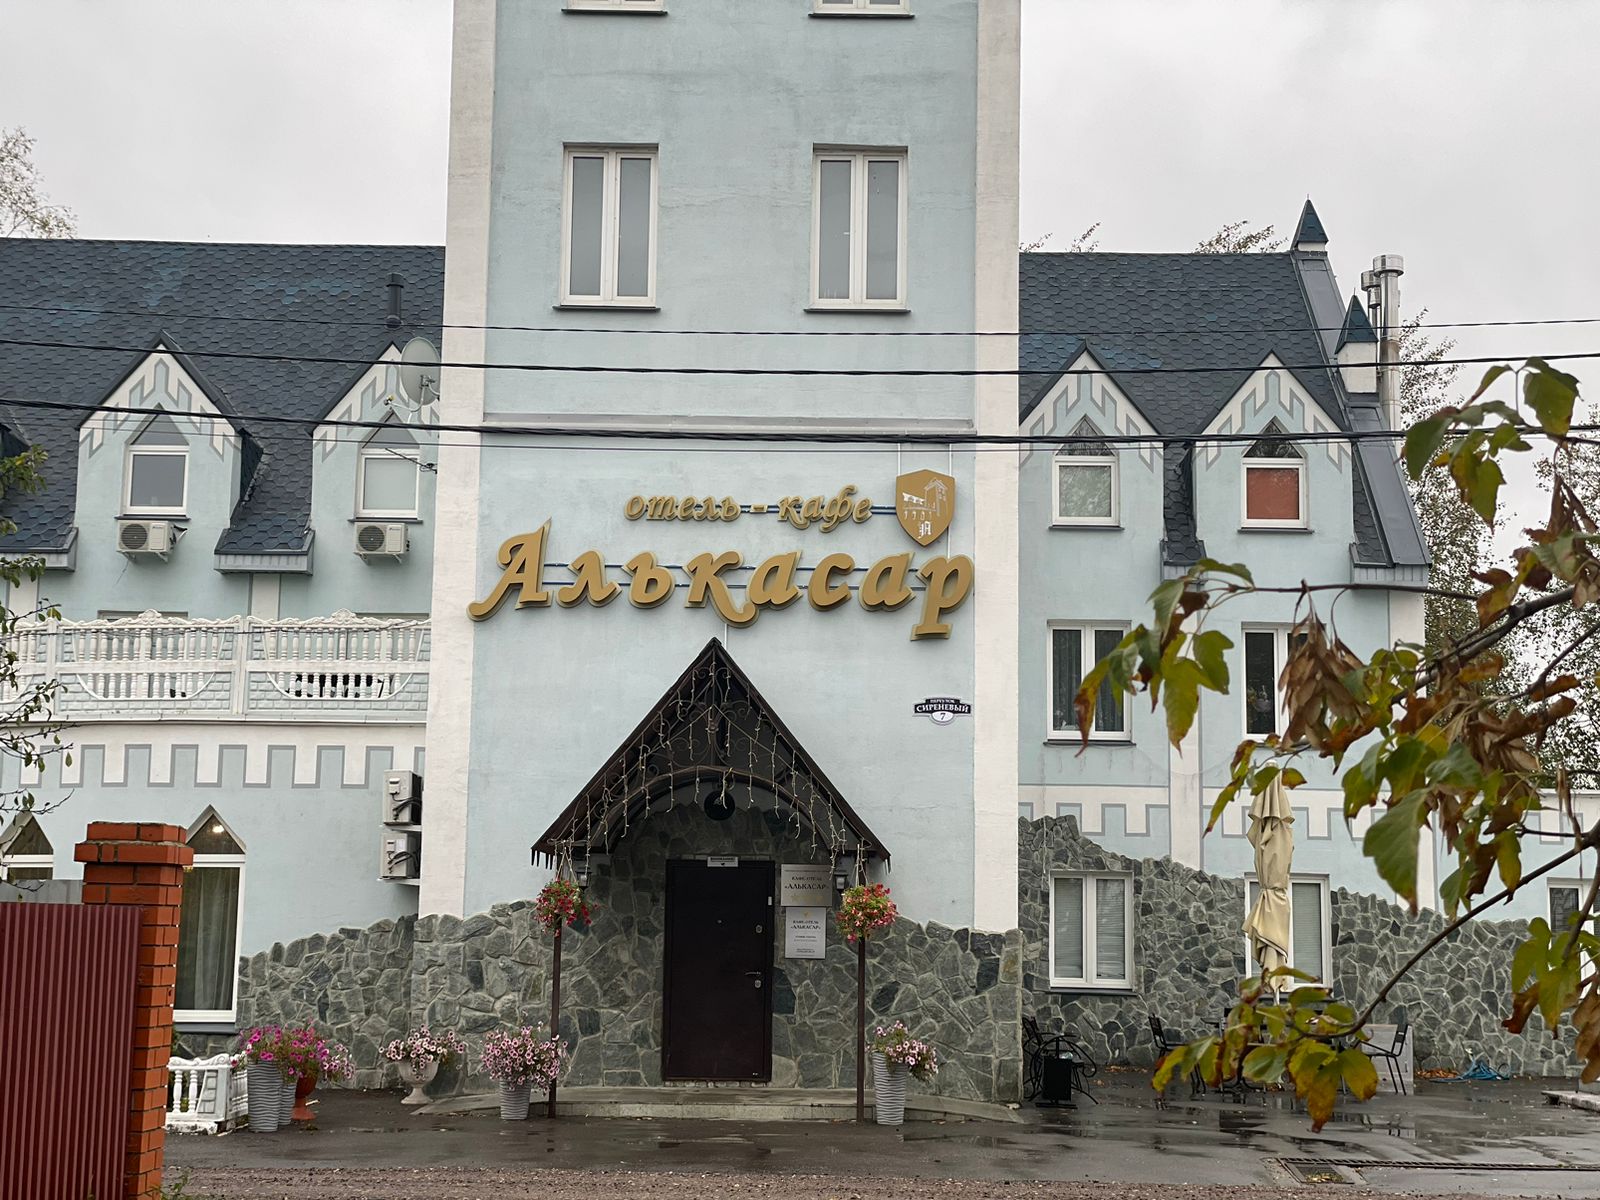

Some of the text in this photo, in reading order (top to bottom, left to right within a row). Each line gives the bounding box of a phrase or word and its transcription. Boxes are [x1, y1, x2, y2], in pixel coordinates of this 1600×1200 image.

[623, 493, 742, 522] отель
[777, 484, 874, 533] кафе
[466, 516, 975, 641] Алькасар
[916, 703, 969, 713] СИРЕНЕВЫЙ
[940, 712, 946, 721] 7
